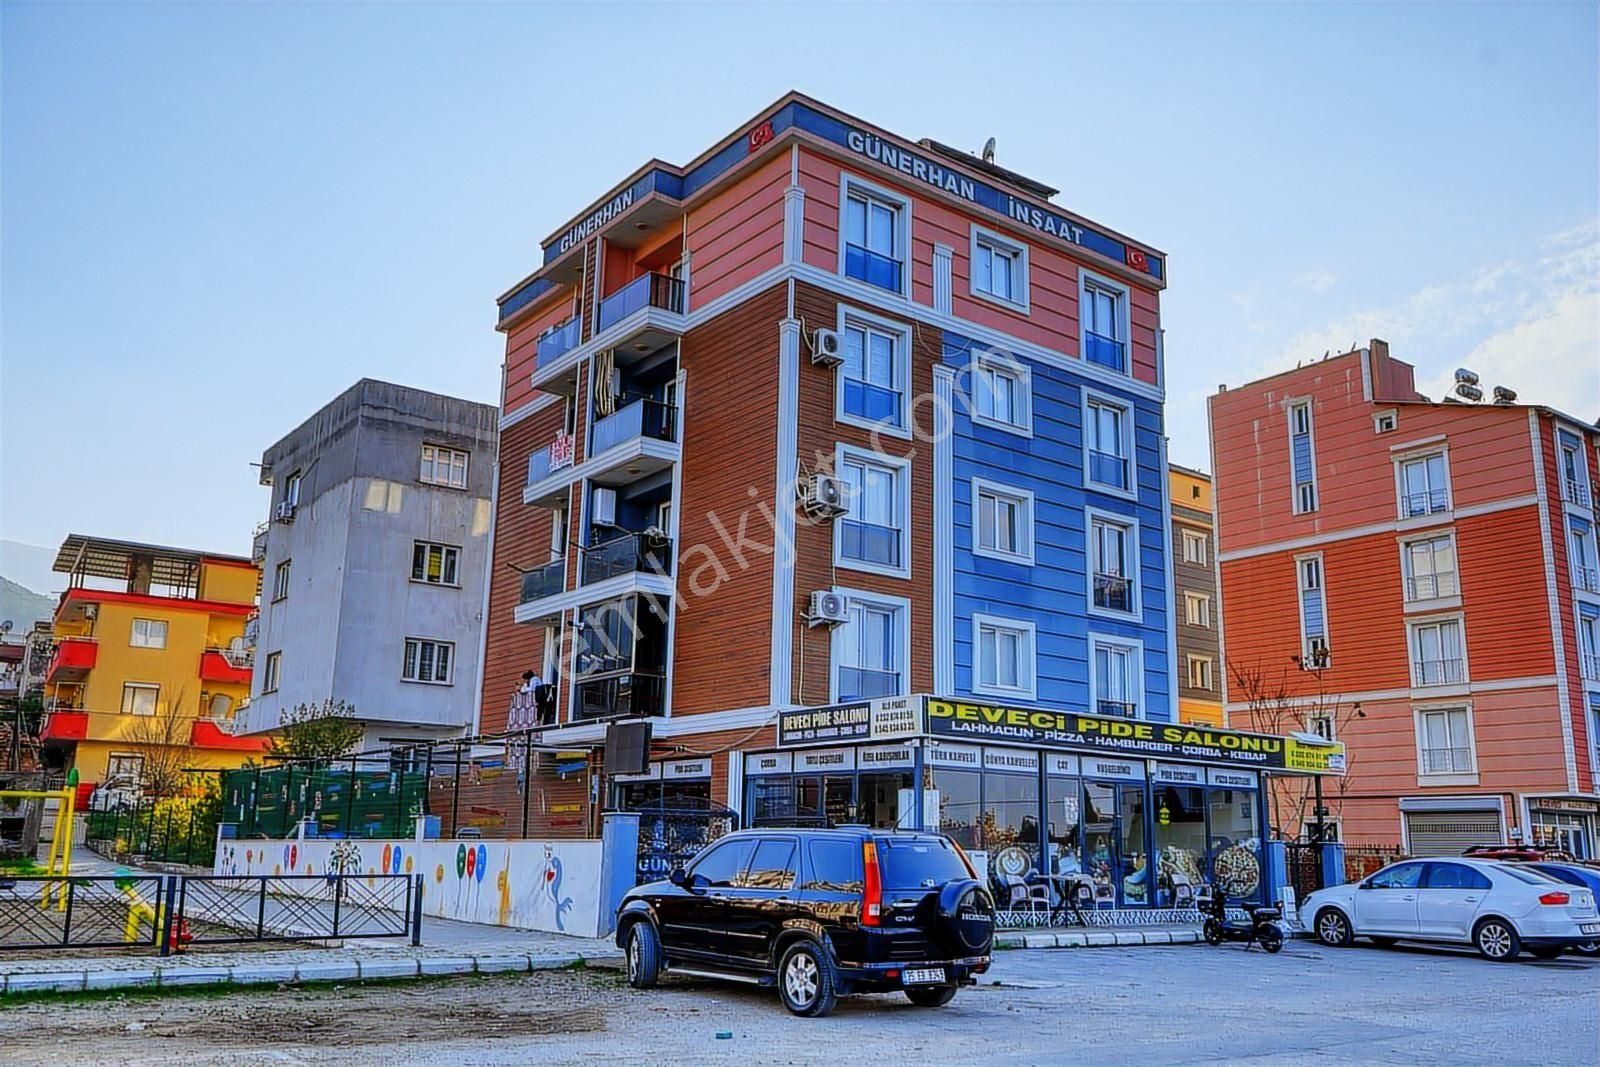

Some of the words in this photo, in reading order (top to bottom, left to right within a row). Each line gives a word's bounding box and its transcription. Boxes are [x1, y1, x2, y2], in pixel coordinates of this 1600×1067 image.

[848, 130, 975, 201] GÜNERHAN
[1008, 196, 1084, 245] İNŞAAT
[833, 707, 869, 725] SALONU
[951, 721, 1034, 738] LAHMACUN
[1044, 729, 1085, 743] PİZZA
[1095, 736, 1172, 753] HAMBURGER
[1182, 745, 1221, 758] ÇORBA
[1230, 751, 1267, 761] KEBAP
[1163, 728, 1280, 753] SALONU
[961, 913, 992, 922] HONDA
